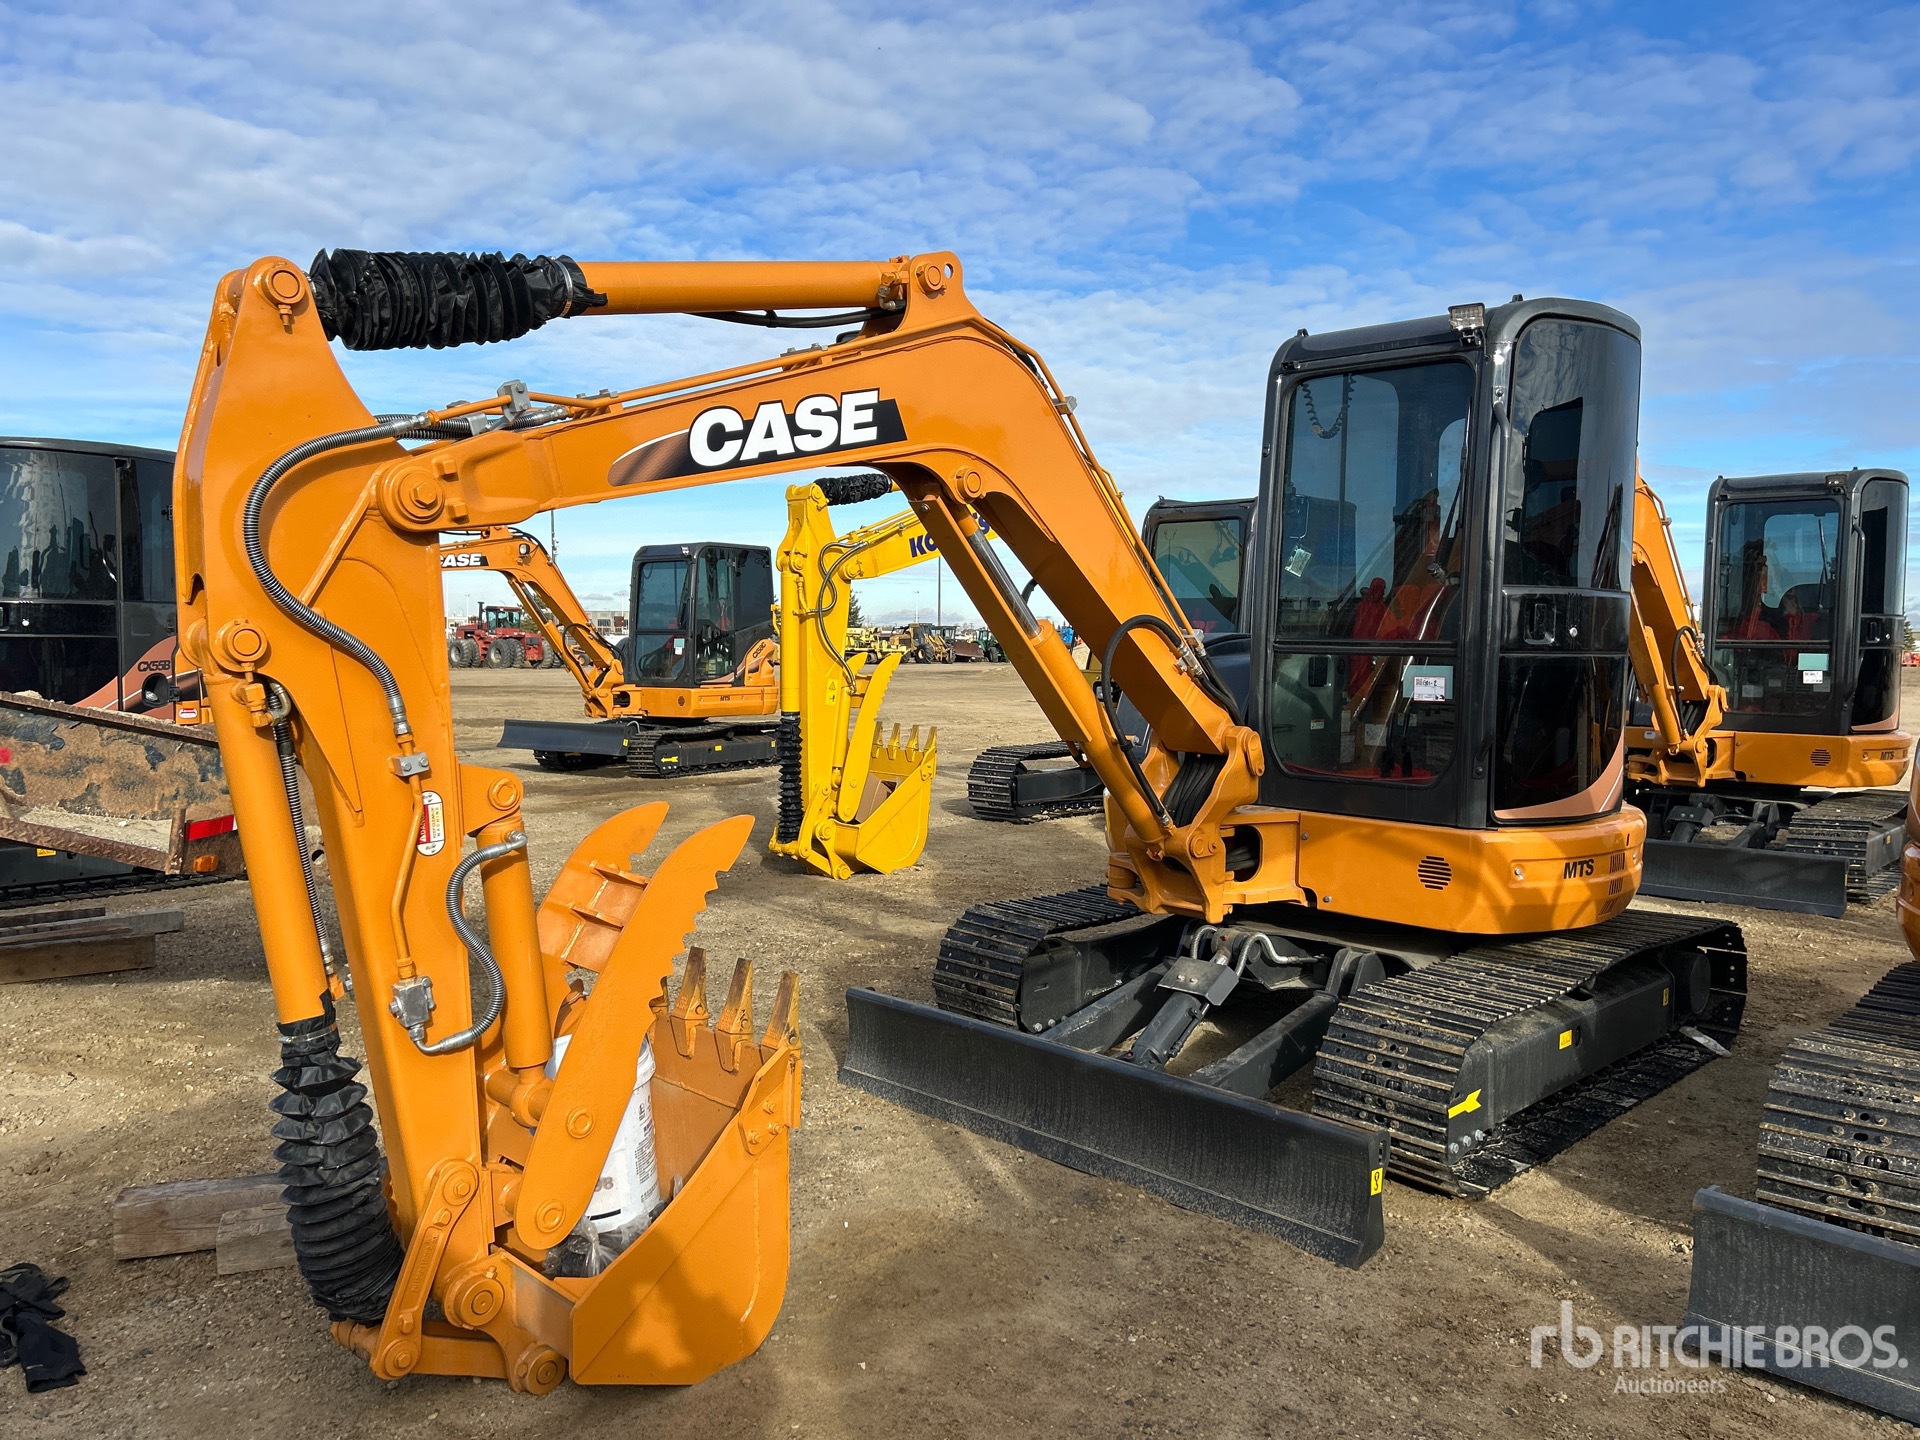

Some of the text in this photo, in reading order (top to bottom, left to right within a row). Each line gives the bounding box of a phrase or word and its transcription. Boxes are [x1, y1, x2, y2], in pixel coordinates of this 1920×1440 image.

[688, 387, 881, 468] CASE
[440, 553, 482, 567] ASE
[137, 660, 171, 672] CX55B
[1880, 751, 1895, 760] MTS
[1563, 858, 1595, 880] MTS
